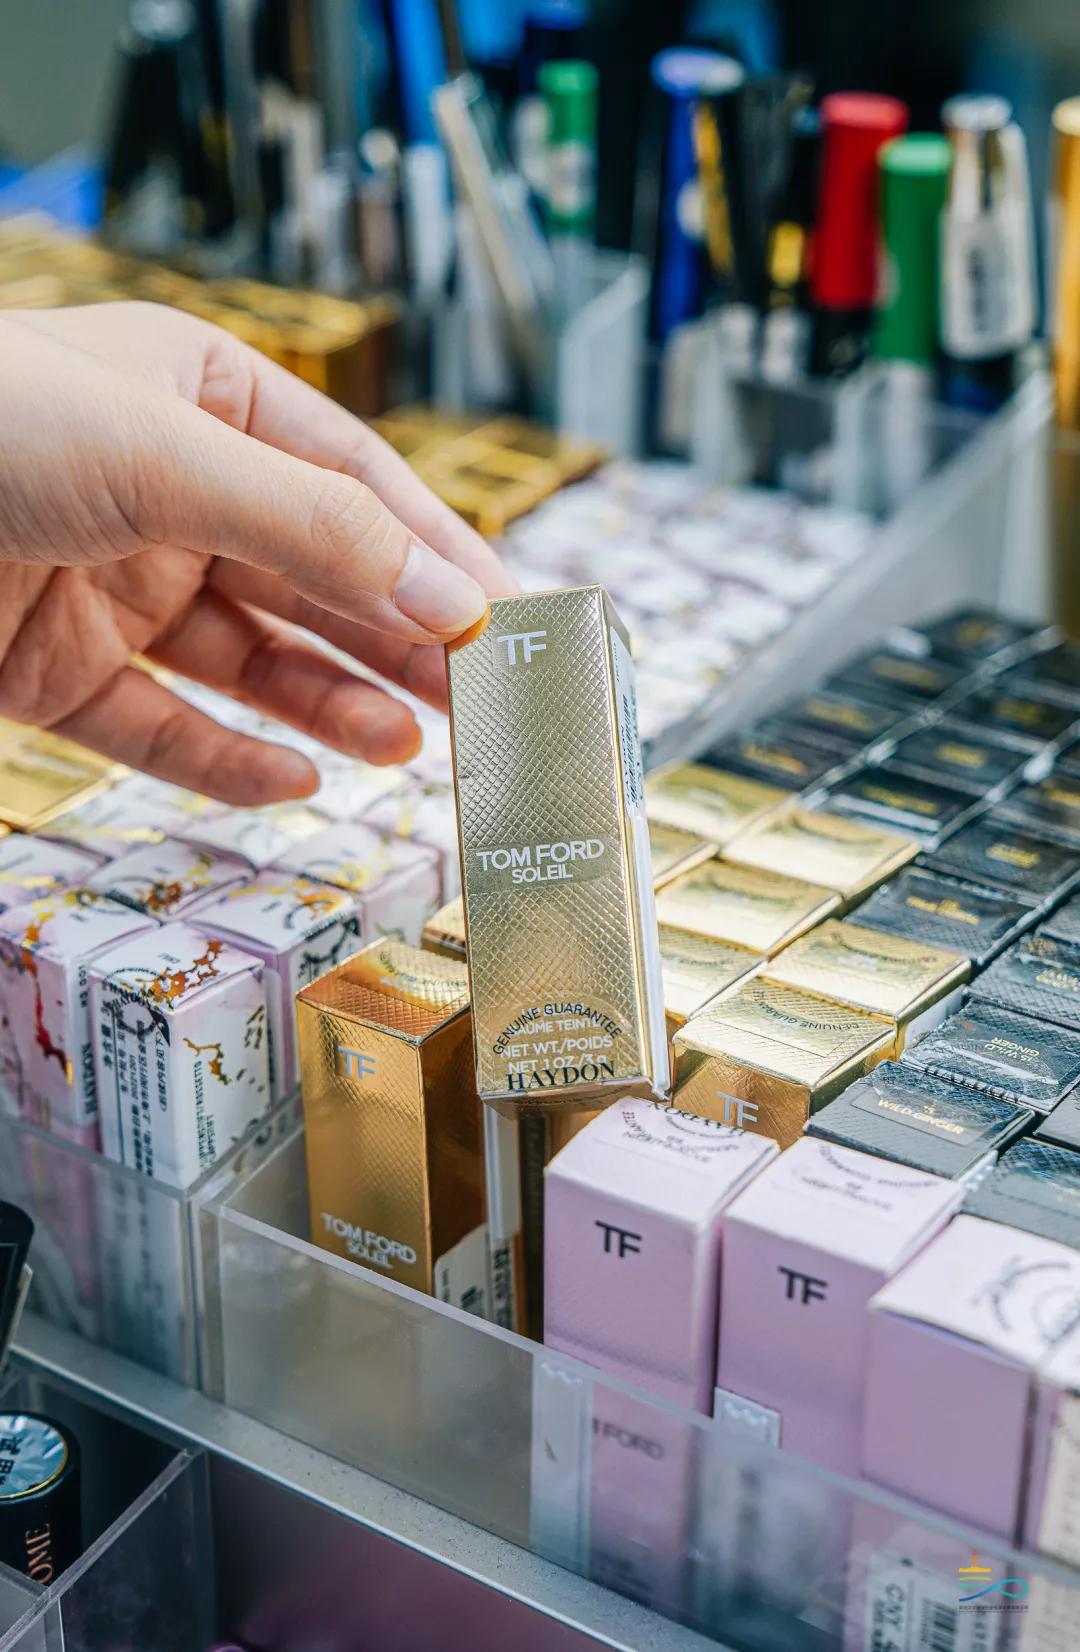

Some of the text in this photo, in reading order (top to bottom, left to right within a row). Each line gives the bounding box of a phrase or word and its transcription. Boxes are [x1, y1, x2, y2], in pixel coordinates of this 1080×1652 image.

[497, 630, 548, 666] TF
[476, 838, 605, 871] TOM FORD
[511, 864, 573, 884] SOLEIL
[492, 1003, 623, 1056] GENUINE GUARANTEE
[500, 1035, 613, 1058] NET WT./POIDS
[990, 1036, 1041, 1058] GINGER
[336, 1044, 378, 1081] TF
[505, 1060, 616, 1091] HAYDON
[508, 1059, 539, 1075] NET
[716, 1090, 760, 1128] TF
[878, 1098, 913, 1115] WILD
[320, 1211, 417, 1265] TOM FORD
[594, 1219, 643, 1260] TF
[776, 1265, 829, 1306] TF
[602, 1421, 665, 1461] FORD
